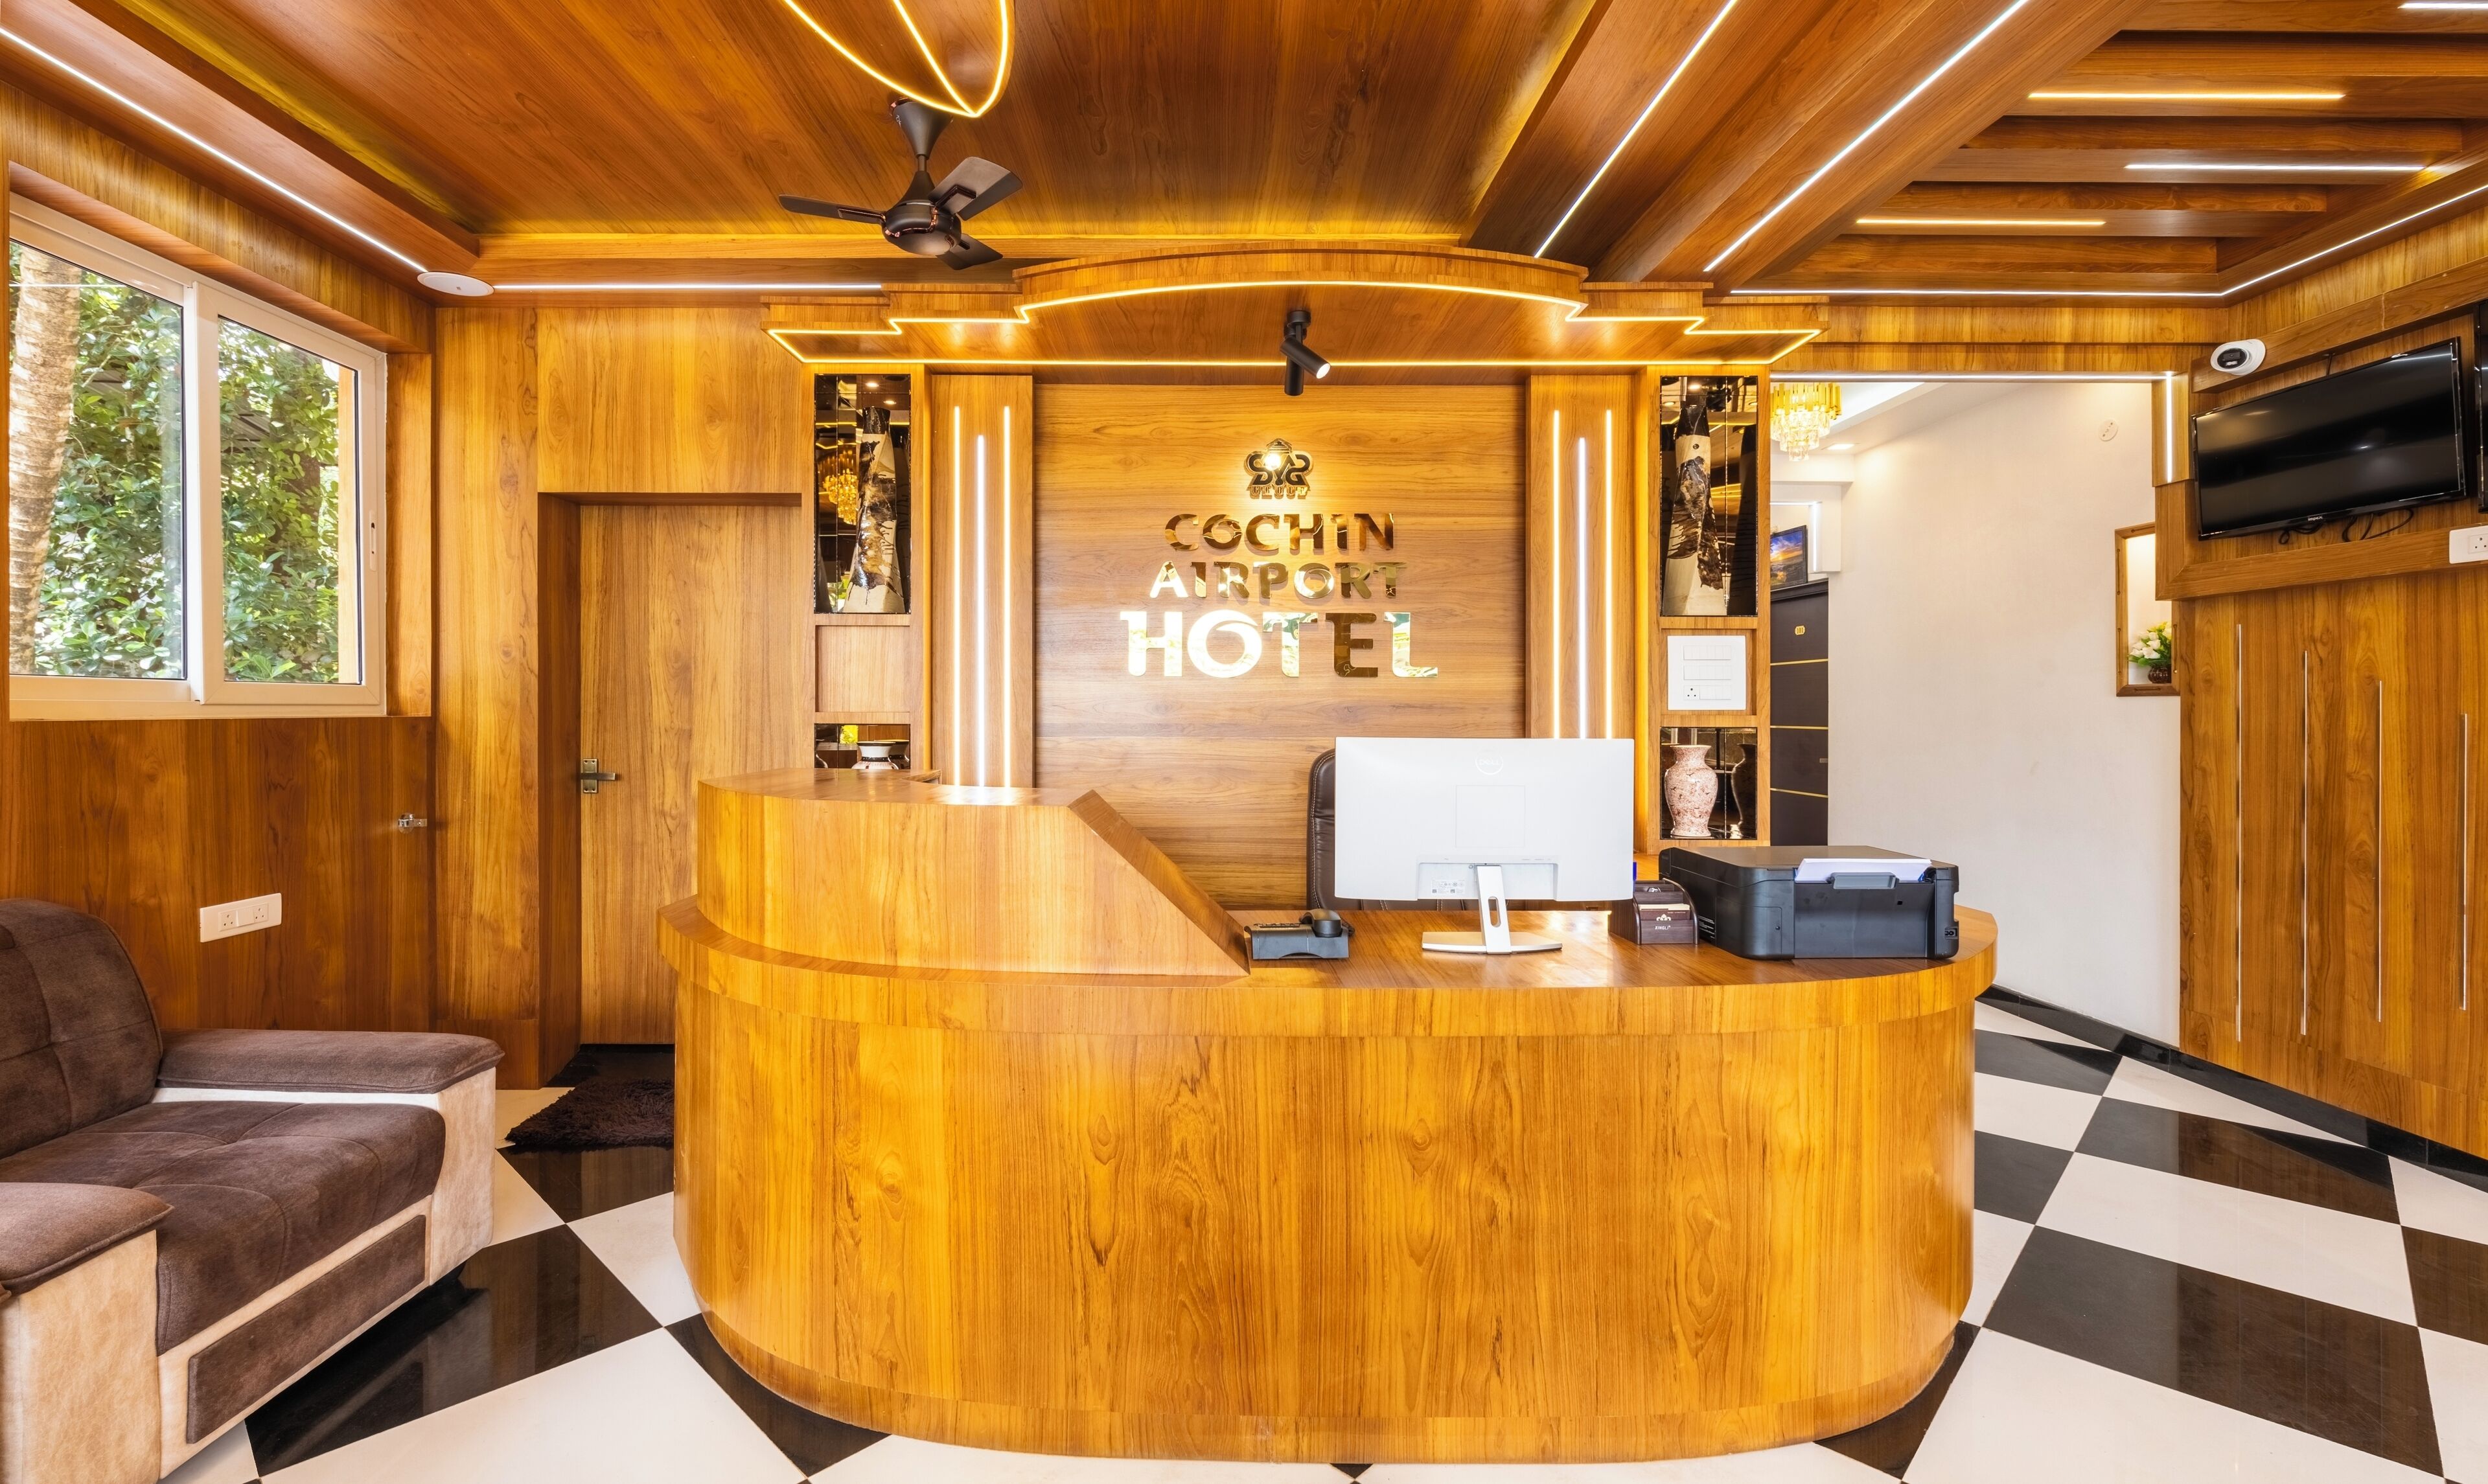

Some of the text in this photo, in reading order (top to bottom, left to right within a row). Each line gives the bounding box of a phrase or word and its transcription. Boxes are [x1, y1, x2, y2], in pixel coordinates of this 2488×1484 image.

[1164, 513, 1395, 551] COCHIN
[1149, 560, 1407, 599] AIRPORT
[1120, 609, 1438, 678] HOTEL
